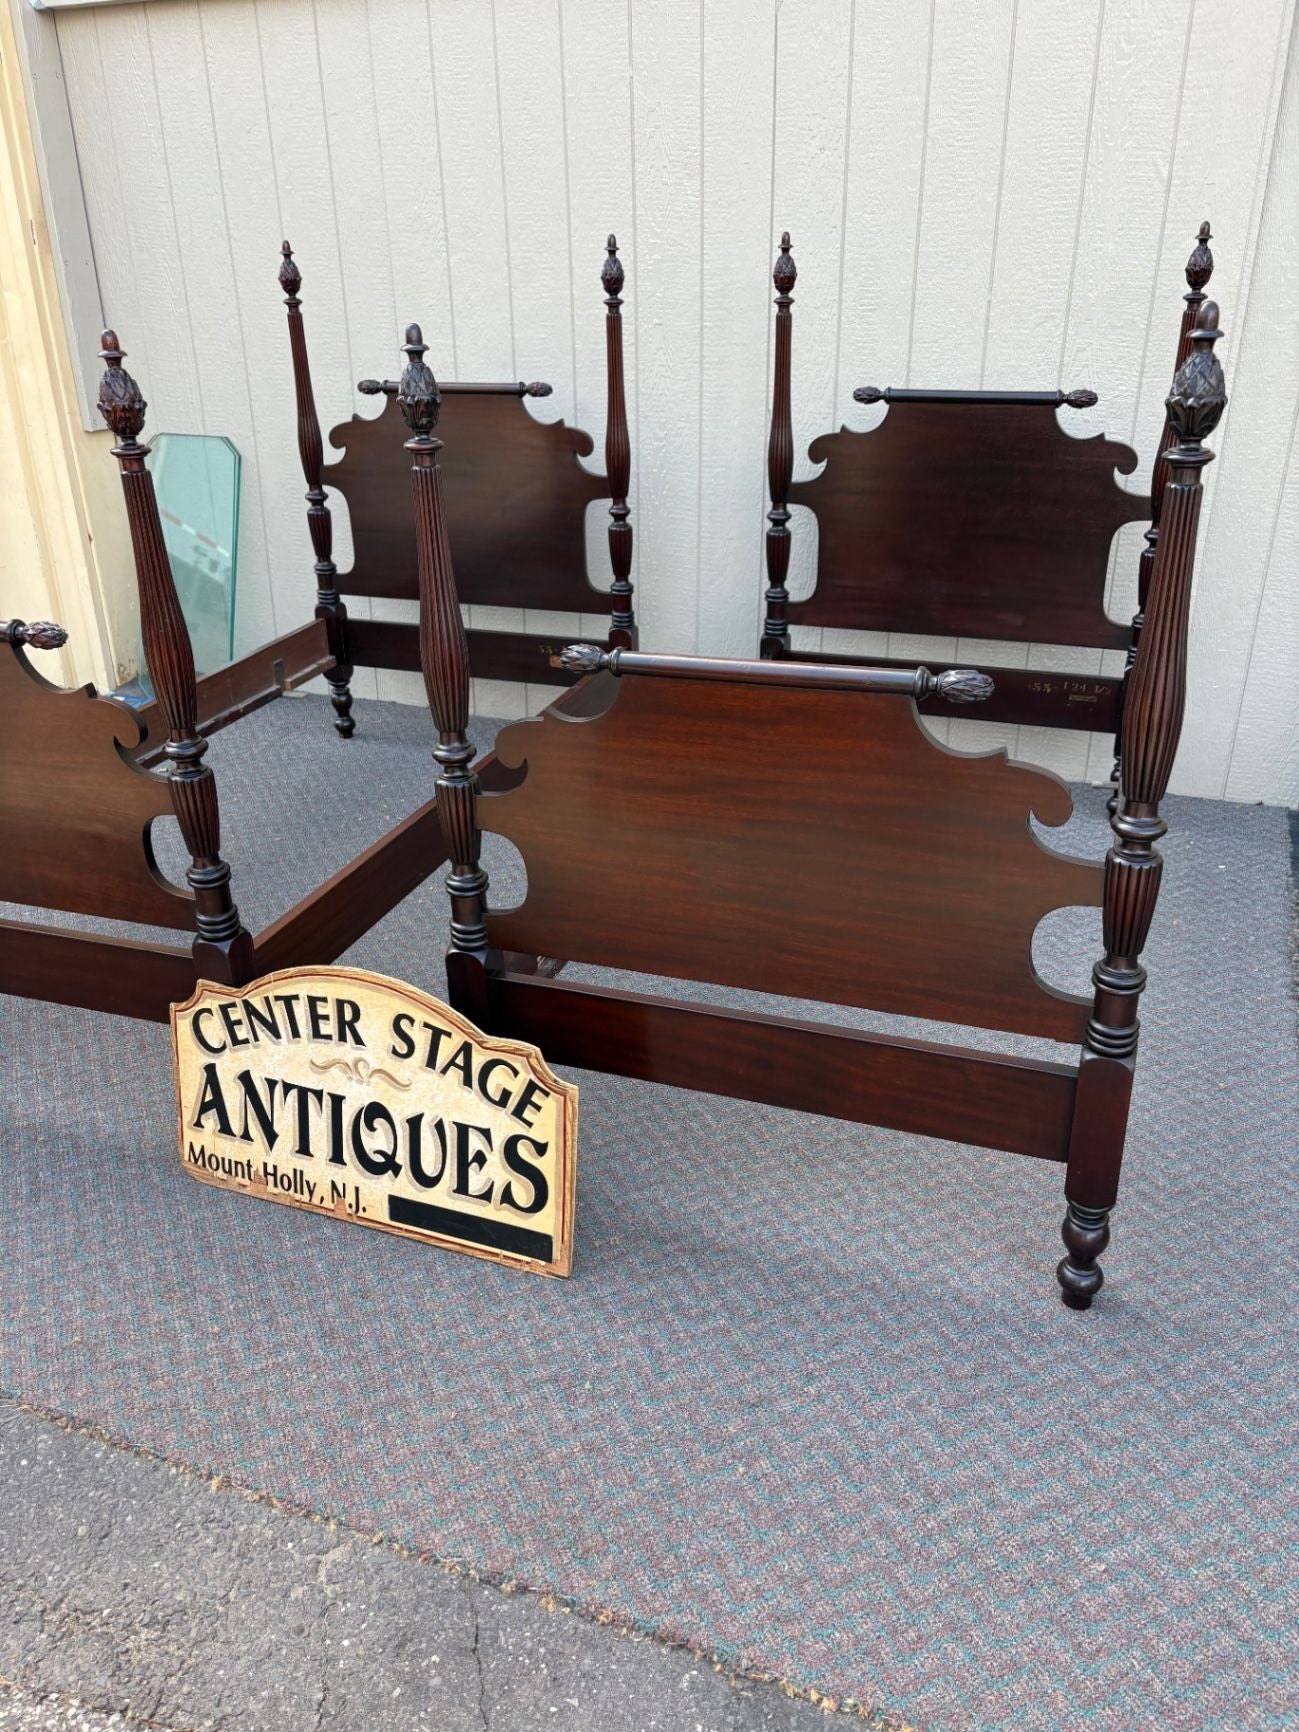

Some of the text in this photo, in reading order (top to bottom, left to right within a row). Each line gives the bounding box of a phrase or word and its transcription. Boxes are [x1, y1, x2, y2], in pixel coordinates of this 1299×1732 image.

[191, 994, 550, 1128] CENTER STAGE
[188, 1141, 367, 1214] Mount Holly, N.J.
[193, 1063, 549, 1214] ANTIQUES
